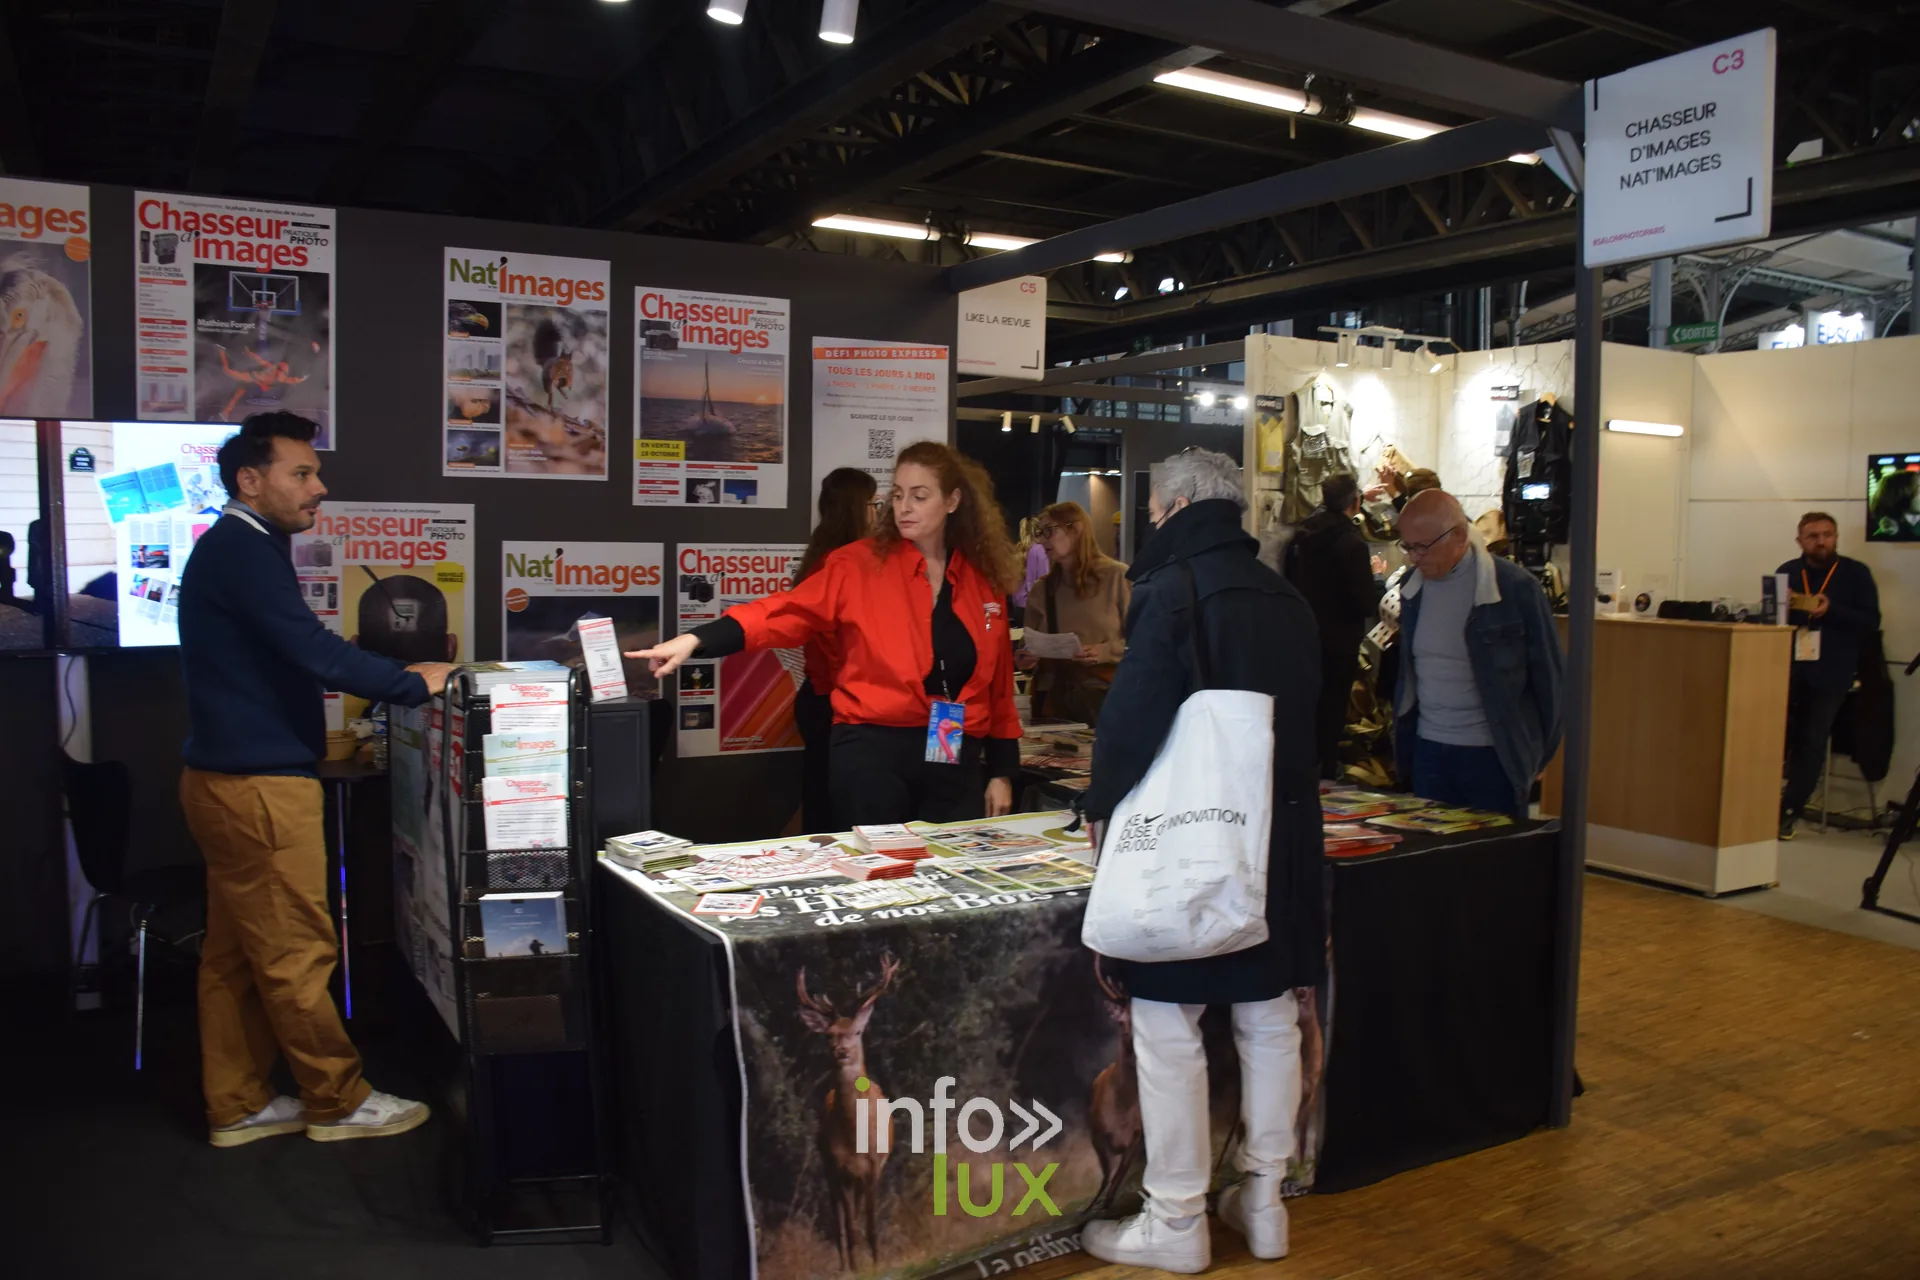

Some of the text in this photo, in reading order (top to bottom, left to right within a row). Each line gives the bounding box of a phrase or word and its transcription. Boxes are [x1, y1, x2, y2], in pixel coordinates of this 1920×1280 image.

[1711, 48, 1745, 75] C3
[1624, 101, 1717, 139] CHASSEUR
[1629, 129, 1712, 163] D'IMAGES
[1619, 153, 1723, 191] NAT'IMAGES
[138, 199, 289, 241] Chasseur
[289, 236, 329, 247] PHOTO
[1020, 282, 1037, 294] C5
[640, 293, 754, 326] Chasseur
[965, 312, 1031, 328] LIKE LA REVUE
[754, 322, 786, 331] PHOTO
[1681, 325, 1716, 341] SORTIE
[825, 347, 937, 358] DÉFI PHOTO EXPRESS
[827, 365, 853, 376] TOUS
[854, 367, 872, 377] LES
[874, 368, 905, 379] JOURS
[914, 371, 936, 381] MIDI
[429, 532, 466, 541] PHOTO
[679, 548, 791, 574] Chasseur
[709, 571, 794, 596] d'image
[1120, 825, 1152, 841] OUSE
[1167, 808, 1248, 831] INNOVATION
[814, 910, 866, 927] de
[871, 904, 945, 919] nos
